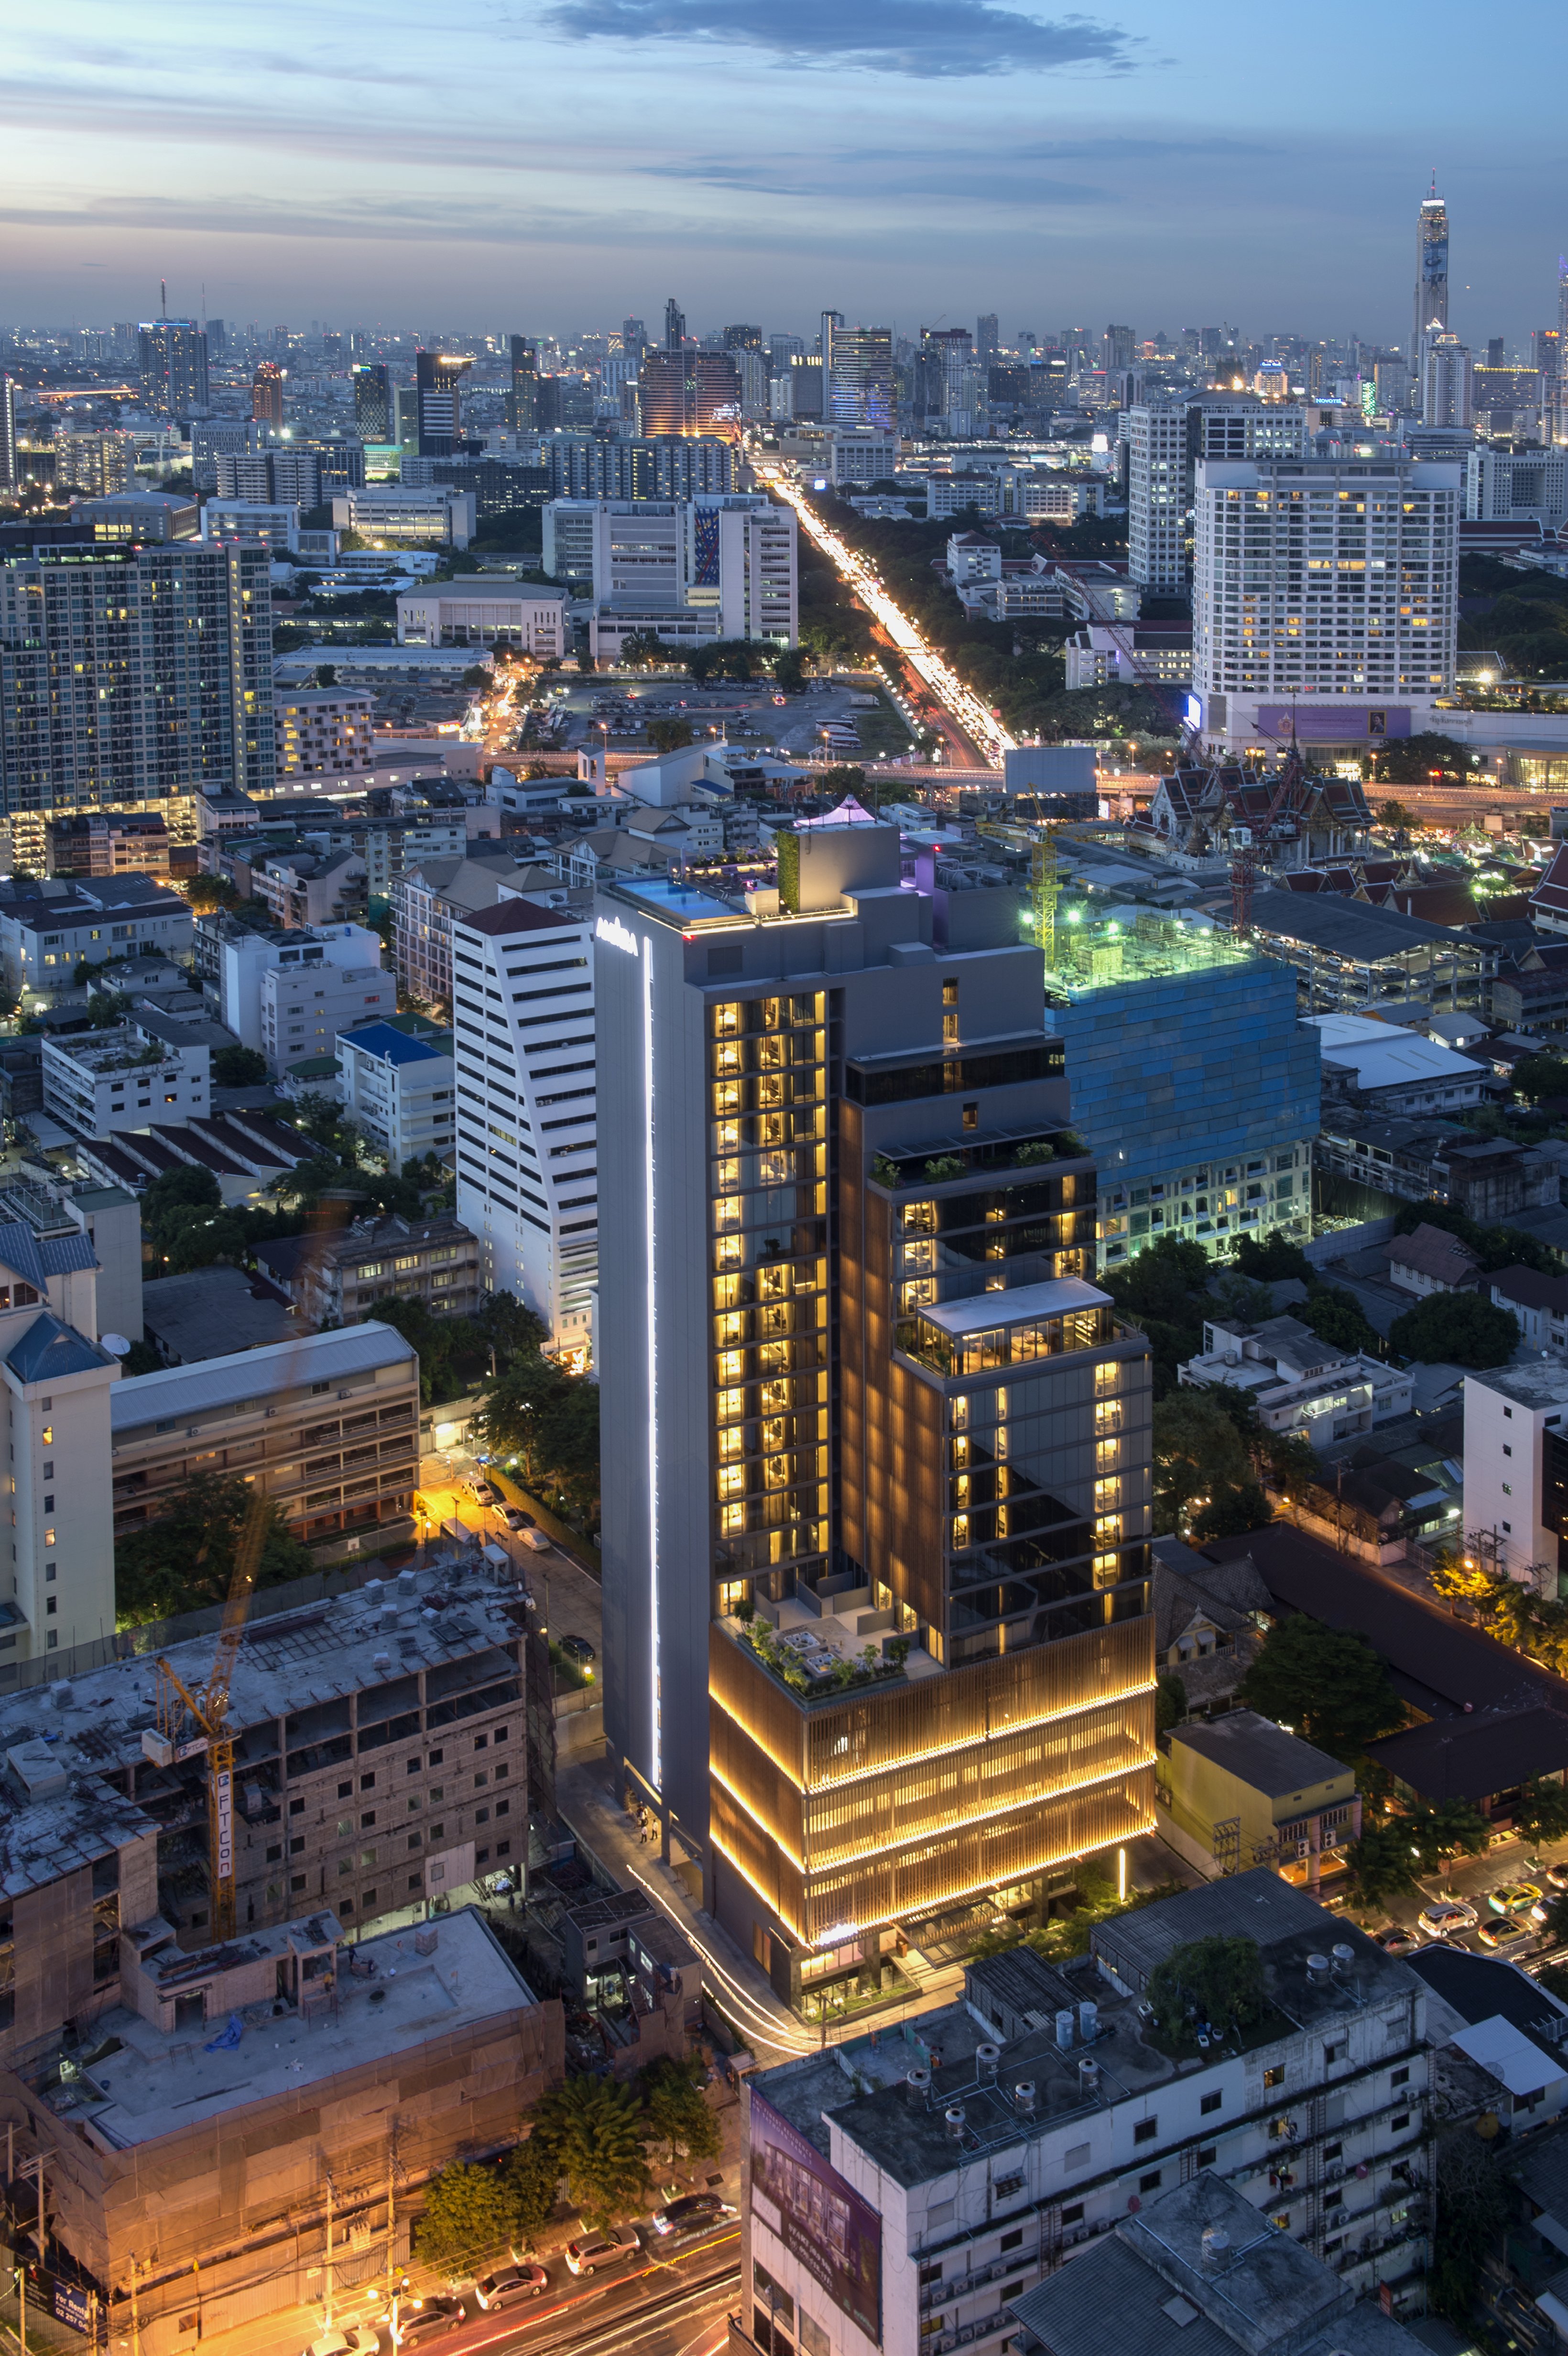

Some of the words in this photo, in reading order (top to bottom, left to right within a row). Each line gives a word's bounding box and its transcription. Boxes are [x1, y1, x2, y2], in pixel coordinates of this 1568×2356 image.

[219, 1794, 230, 1873] FTCon
[764, 2107, 781, 2127] FINEST
[784, 2126, 812, 2158] RESIDENCE
[55, 2292, 66, 2304] For
[55, 2308, 64, 2317] 02
[65, 2313, 77, 2323] 257
